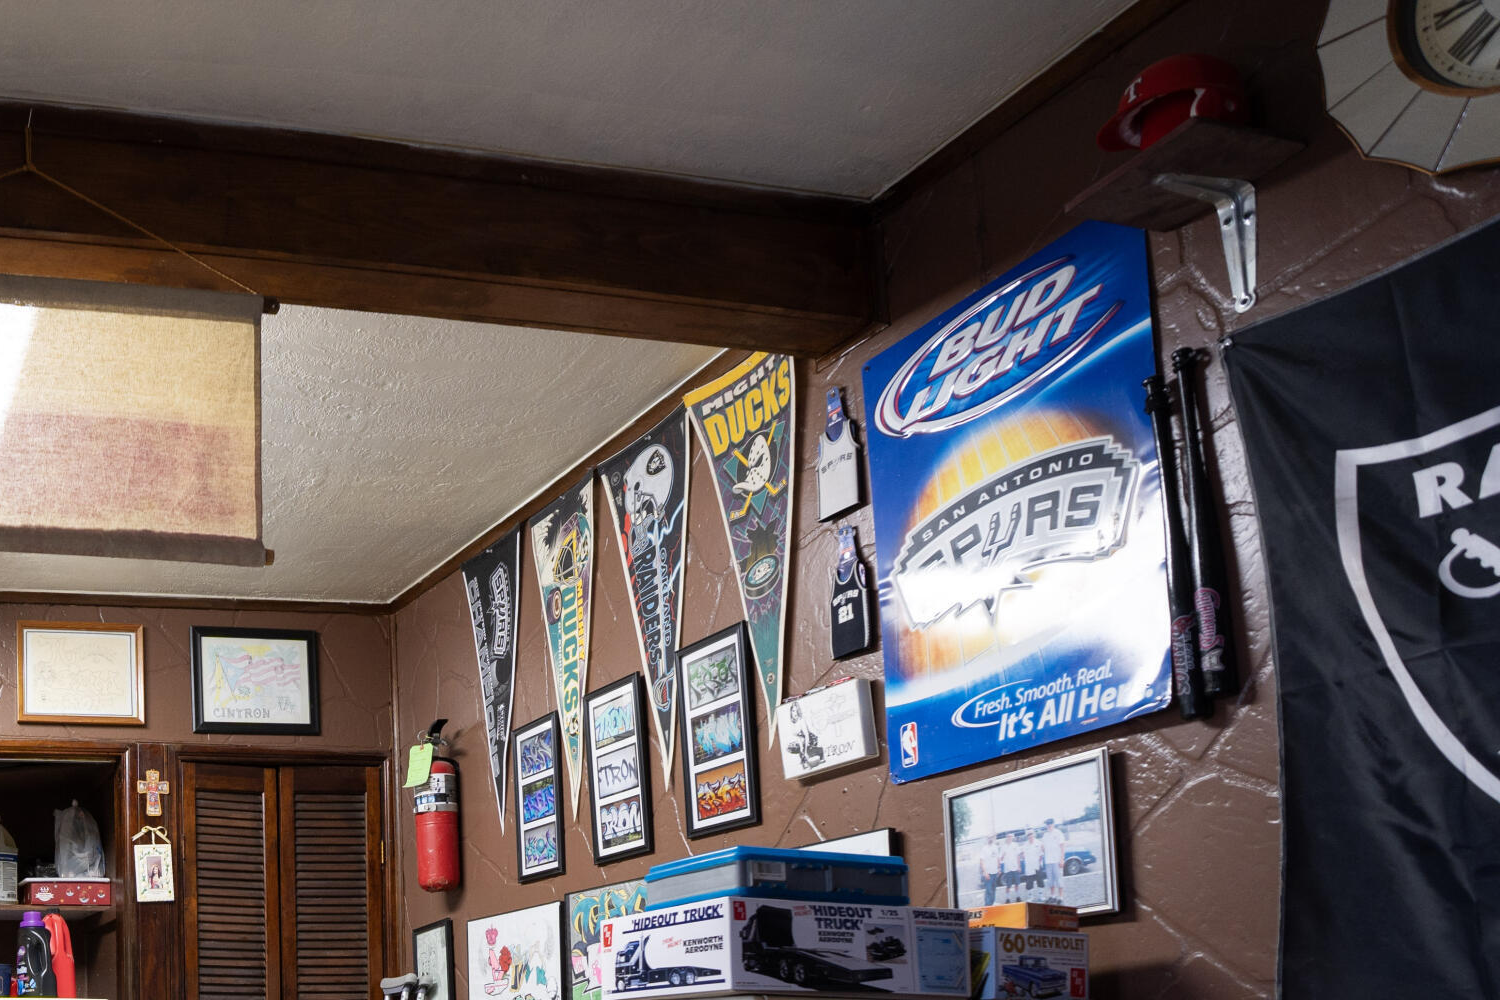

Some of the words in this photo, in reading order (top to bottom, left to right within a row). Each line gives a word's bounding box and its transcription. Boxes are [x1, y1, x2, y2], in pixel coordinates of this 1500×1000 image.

[928, 264, 1077, 381] BUD
[900, 283, 1104, 431] LIGHT
[703, 359, 791, 457] DUCKS
[821, 452, 853, 475] SPURS
[922, 505, 967, 542] SAN
[977, 452, 1094, 506] ANTONIO
[494, 571, 506, 651] SPURS
[576, 579, 585, 661] MIGHTY
[632, 543, 663, 665] RAIDERS
[838, 602, 855, 624] 21
[562, 585, 579, 714] DUCKS
[974, 696, 1013, 720] Fresh.
[1015, 673, 1075, 706] Smooth.
[1075, 659, 1113, 686] Real.
[212, 707, 271, 719] CINTRON
[998, 706, 1035, 742] It's
[1037, 696, 1075, 731] All
[632, 911, 679, 931] 'HIDEOUT
[683, 903, 724, 921] TRUCK'
[810, 904, 873, 919] 'HIDEOUT
[815, 917, 863, 932] TRUCK'
[682, 935, 724, 948] KENWORTH
[684, 943, 724, 955] AERODYNE
[1000, 932, 1026, 954] '60
[1027, 934, 1085, 951] CHEVROLET
